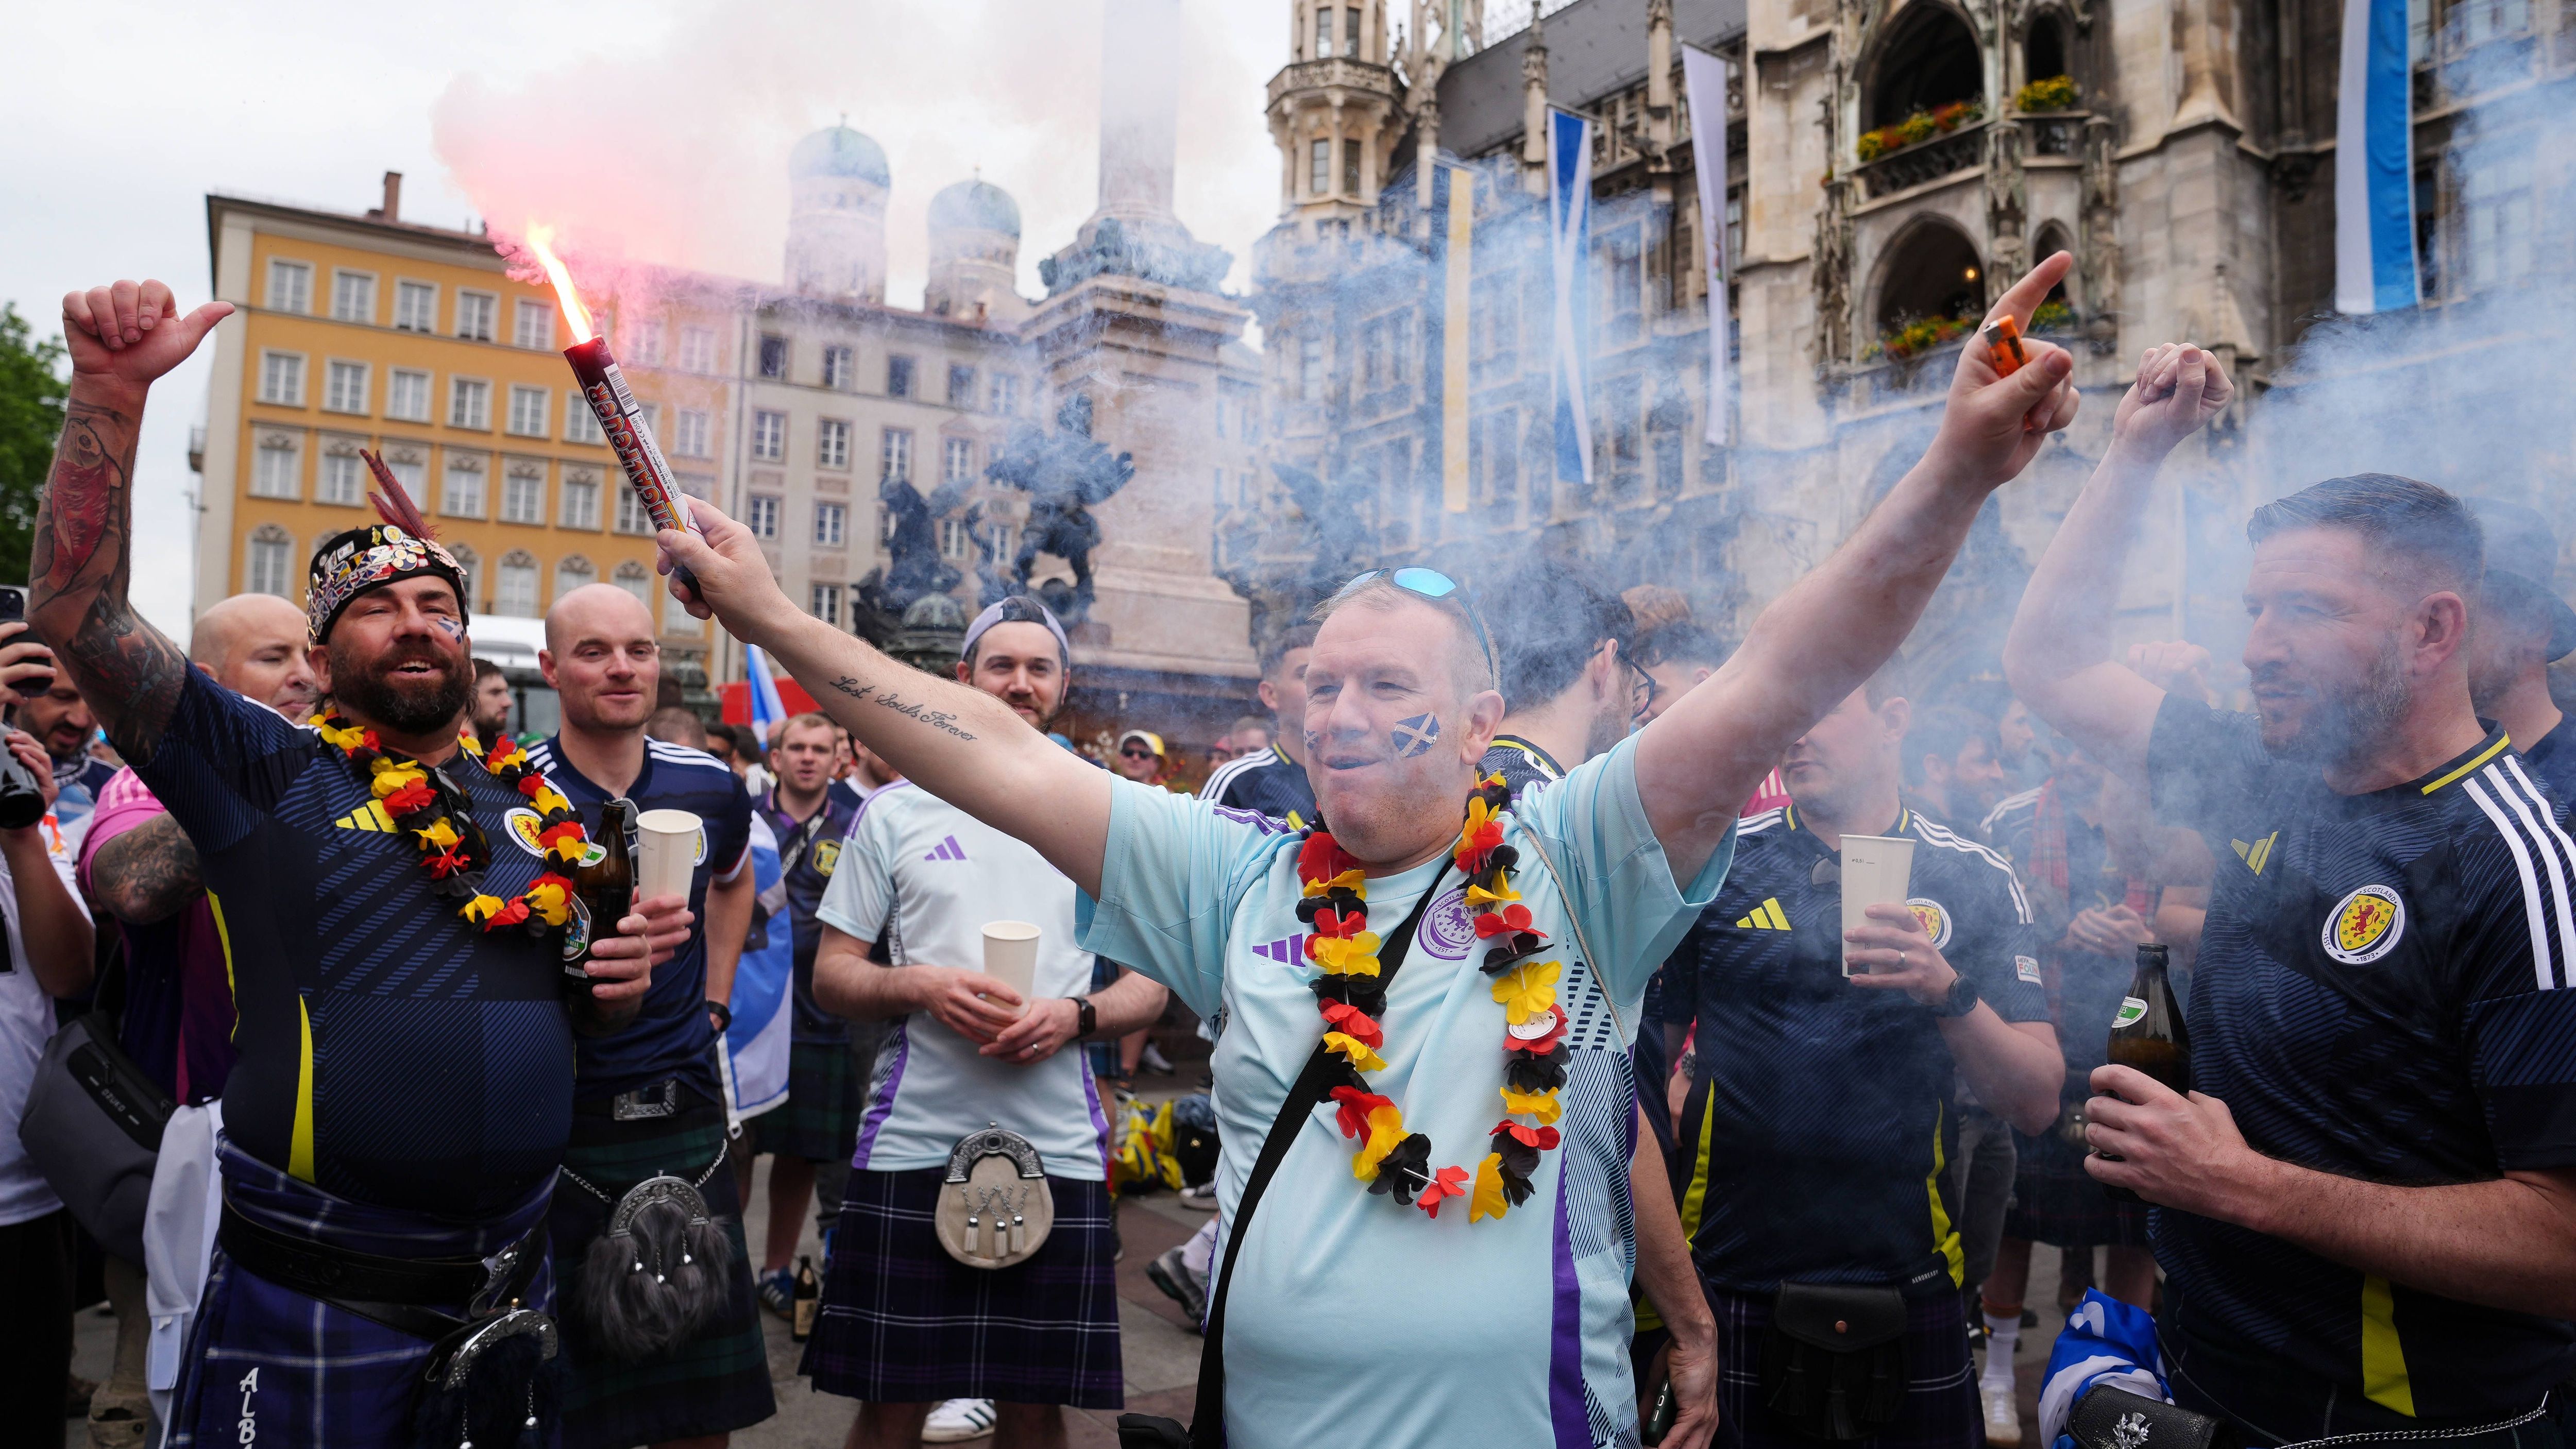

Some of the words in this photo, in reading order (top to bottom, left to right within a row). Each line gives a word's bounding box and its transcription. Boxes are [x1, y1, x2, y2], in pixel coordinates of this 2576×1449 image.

[829, 676, 876, 699] Lost
[874, 693, 924, 718] Souls
[920, 711, 978, 742] Forever
[2363, 887, 2396, 902] SCOTLAND
[1907, 899, 1936, 908] SCOTLAND
[2360, 953, 2376, 962] 1873
[1911, 1269, 1939, 1284] AEROREADY
[238, 1367, 259, 1449] ALB
